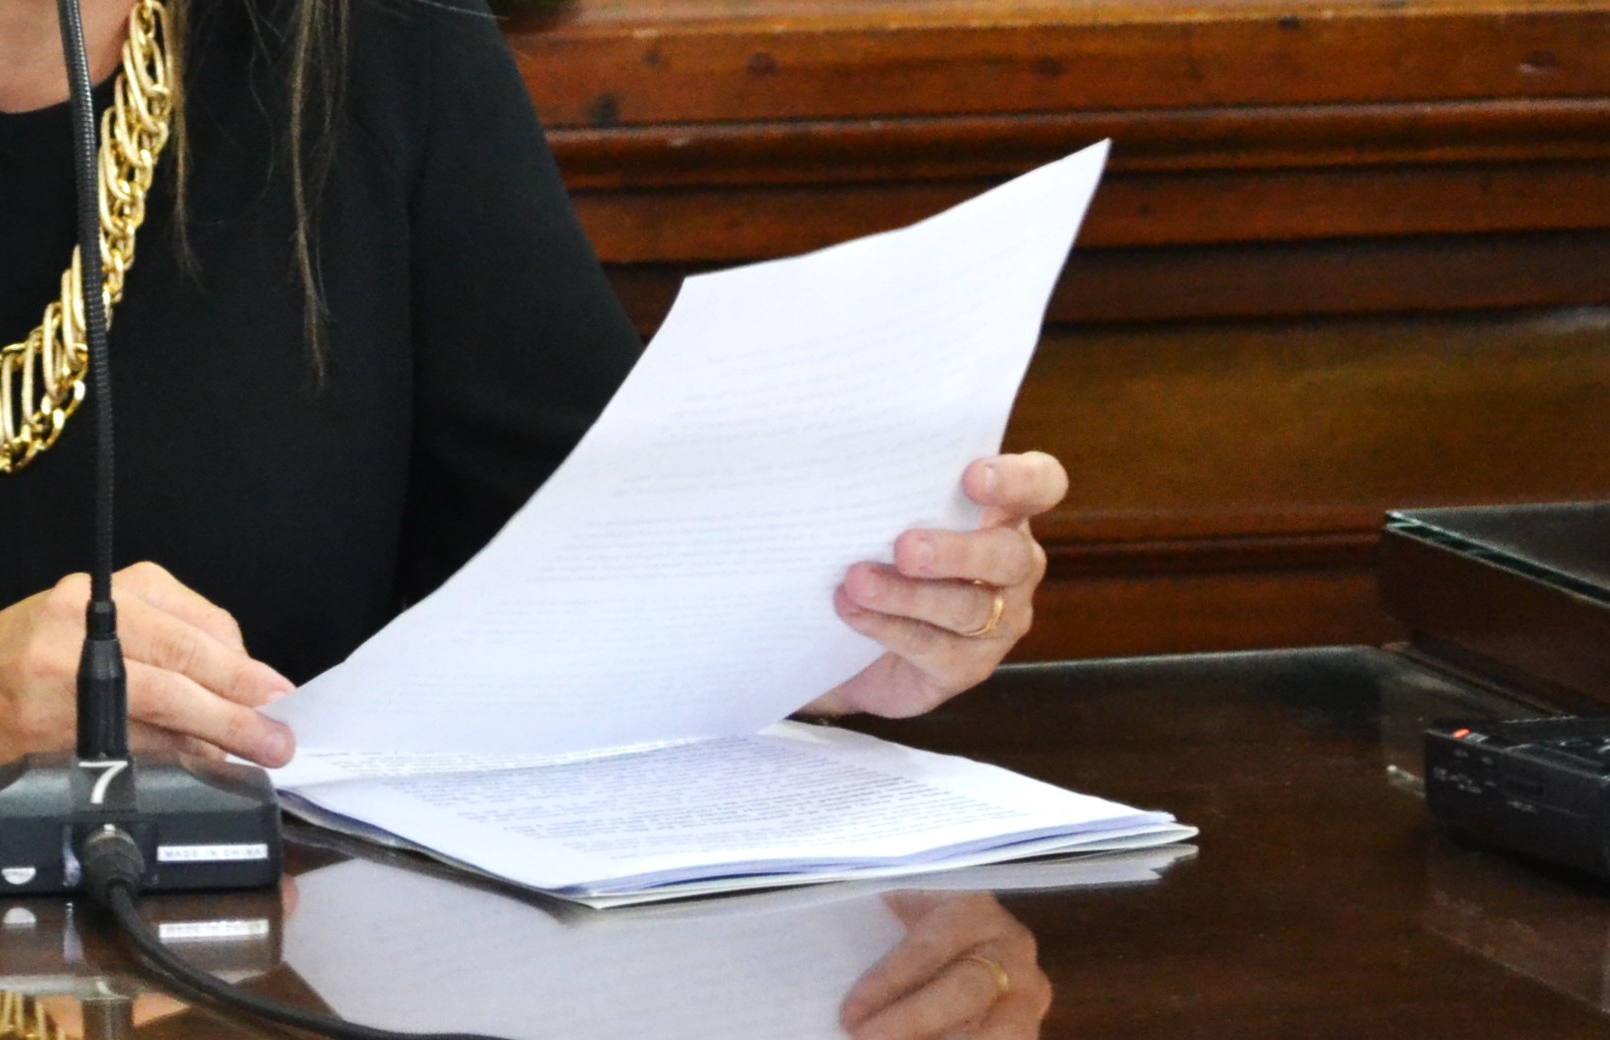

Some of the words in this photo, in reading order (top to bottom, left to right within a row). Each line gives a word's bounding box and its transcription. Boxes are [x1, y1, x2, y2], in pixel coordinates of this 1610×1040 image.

[78, 760, 128, 804] 7
[165, 849, 198, 858] MADE
[205, 849, 218, 857] IN
[223, 847, 263, 857] CHINA
